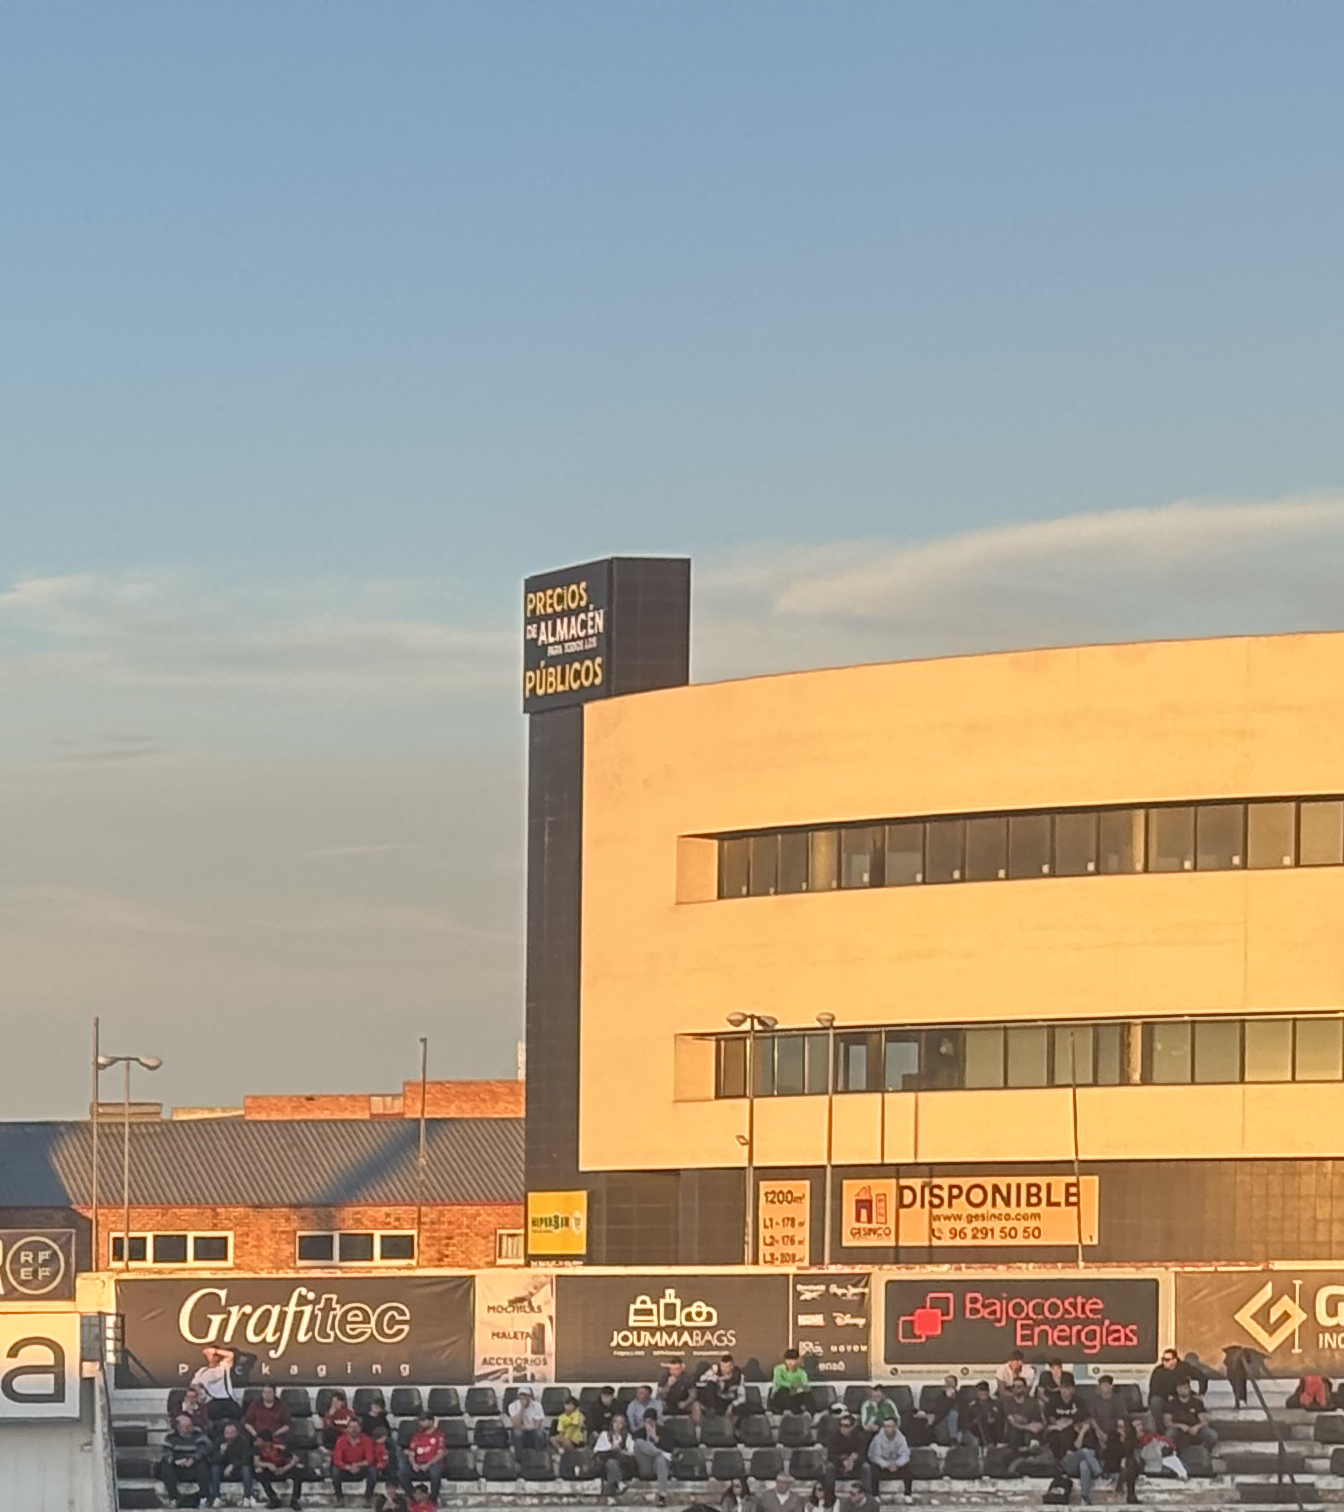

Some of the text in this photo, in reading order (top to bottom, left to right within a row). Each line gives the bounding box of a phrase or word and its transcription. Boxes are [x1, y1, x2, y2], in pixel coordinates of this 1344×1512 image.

[526, 581, 588, 617] PRECIOS
[526, 604, 605, 646] DE ALMACÉN
[525, 656, 603, 698] PÚBLICOS
[899, 1182, 1078, 1209] DISPONIBLE
[949, 1227, 1041, 1240] 96 291 50 50
[177, 1287, 411, 1359] Grafitec
[964, 1293, 1104, 1330] Bajocoste
[1016, 1318, 1139, 1354] Energías
